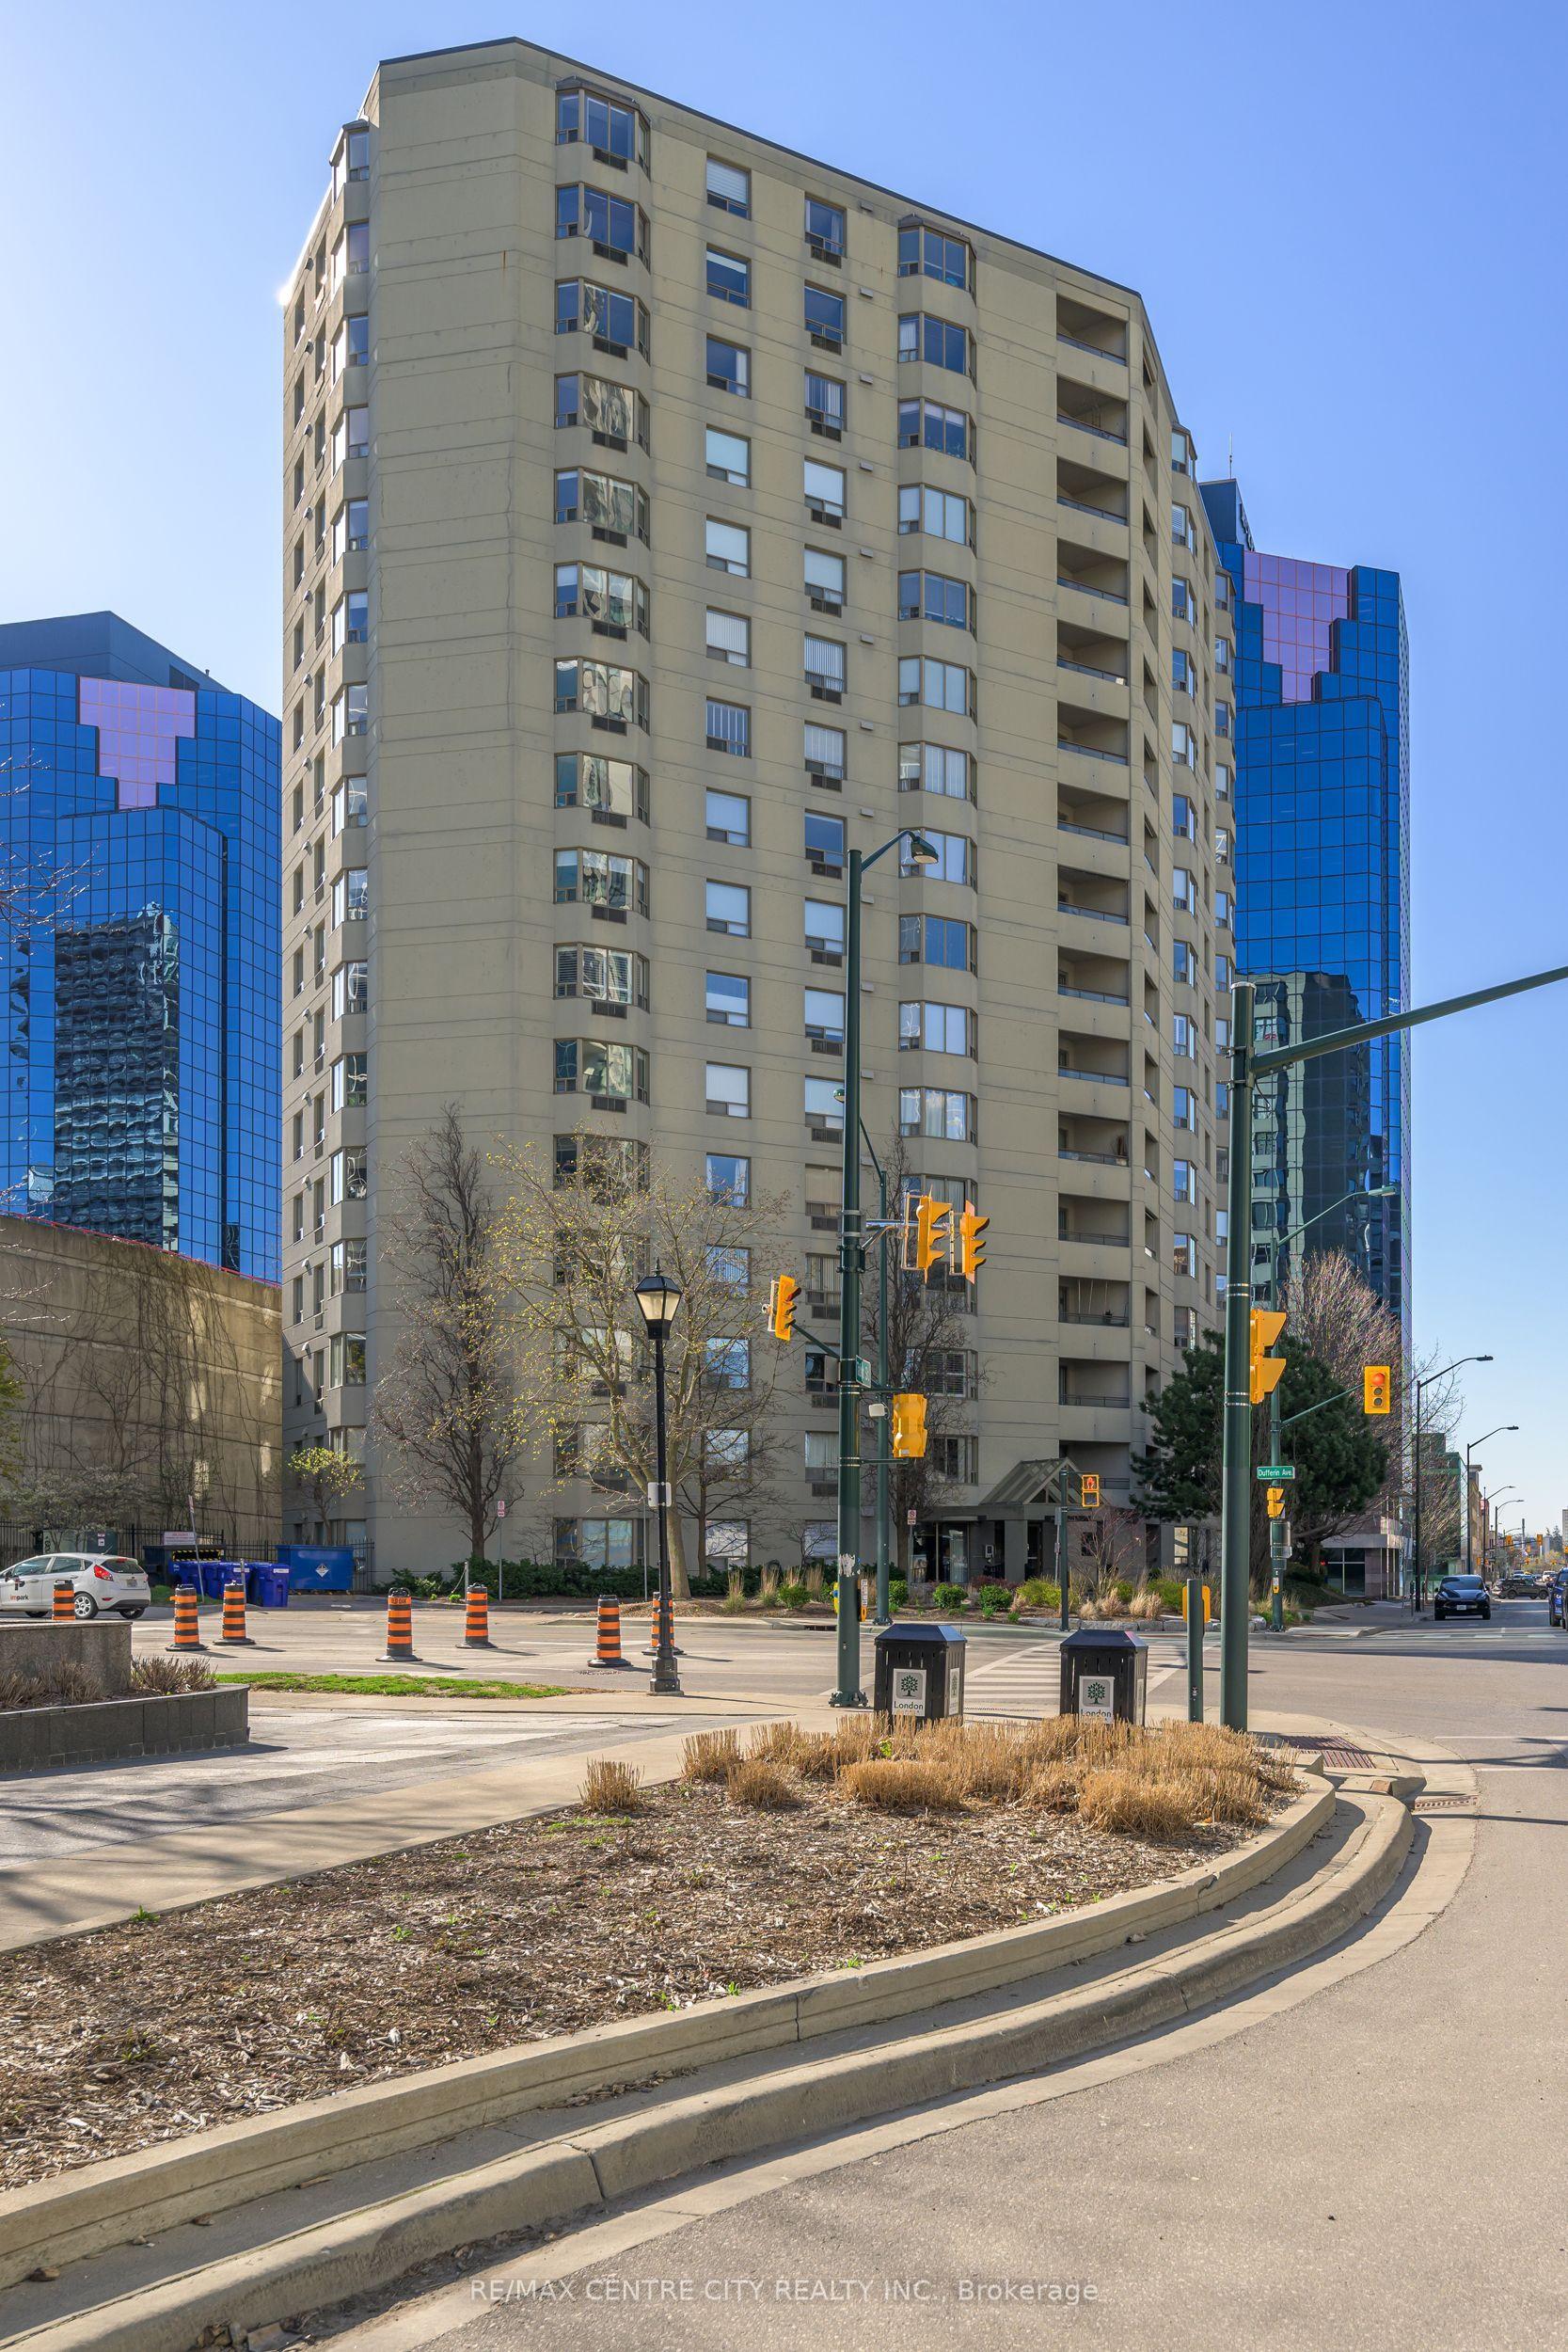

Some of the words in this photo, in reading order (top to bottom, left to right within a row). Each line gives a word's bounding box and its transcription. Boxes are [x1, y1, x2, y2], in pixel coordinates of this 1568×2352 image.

[1258, 1469, 1280, 1477] Dufferin
[894, 1700, 924, 1710] London
[1080, 1708, 1112, 1718] London
